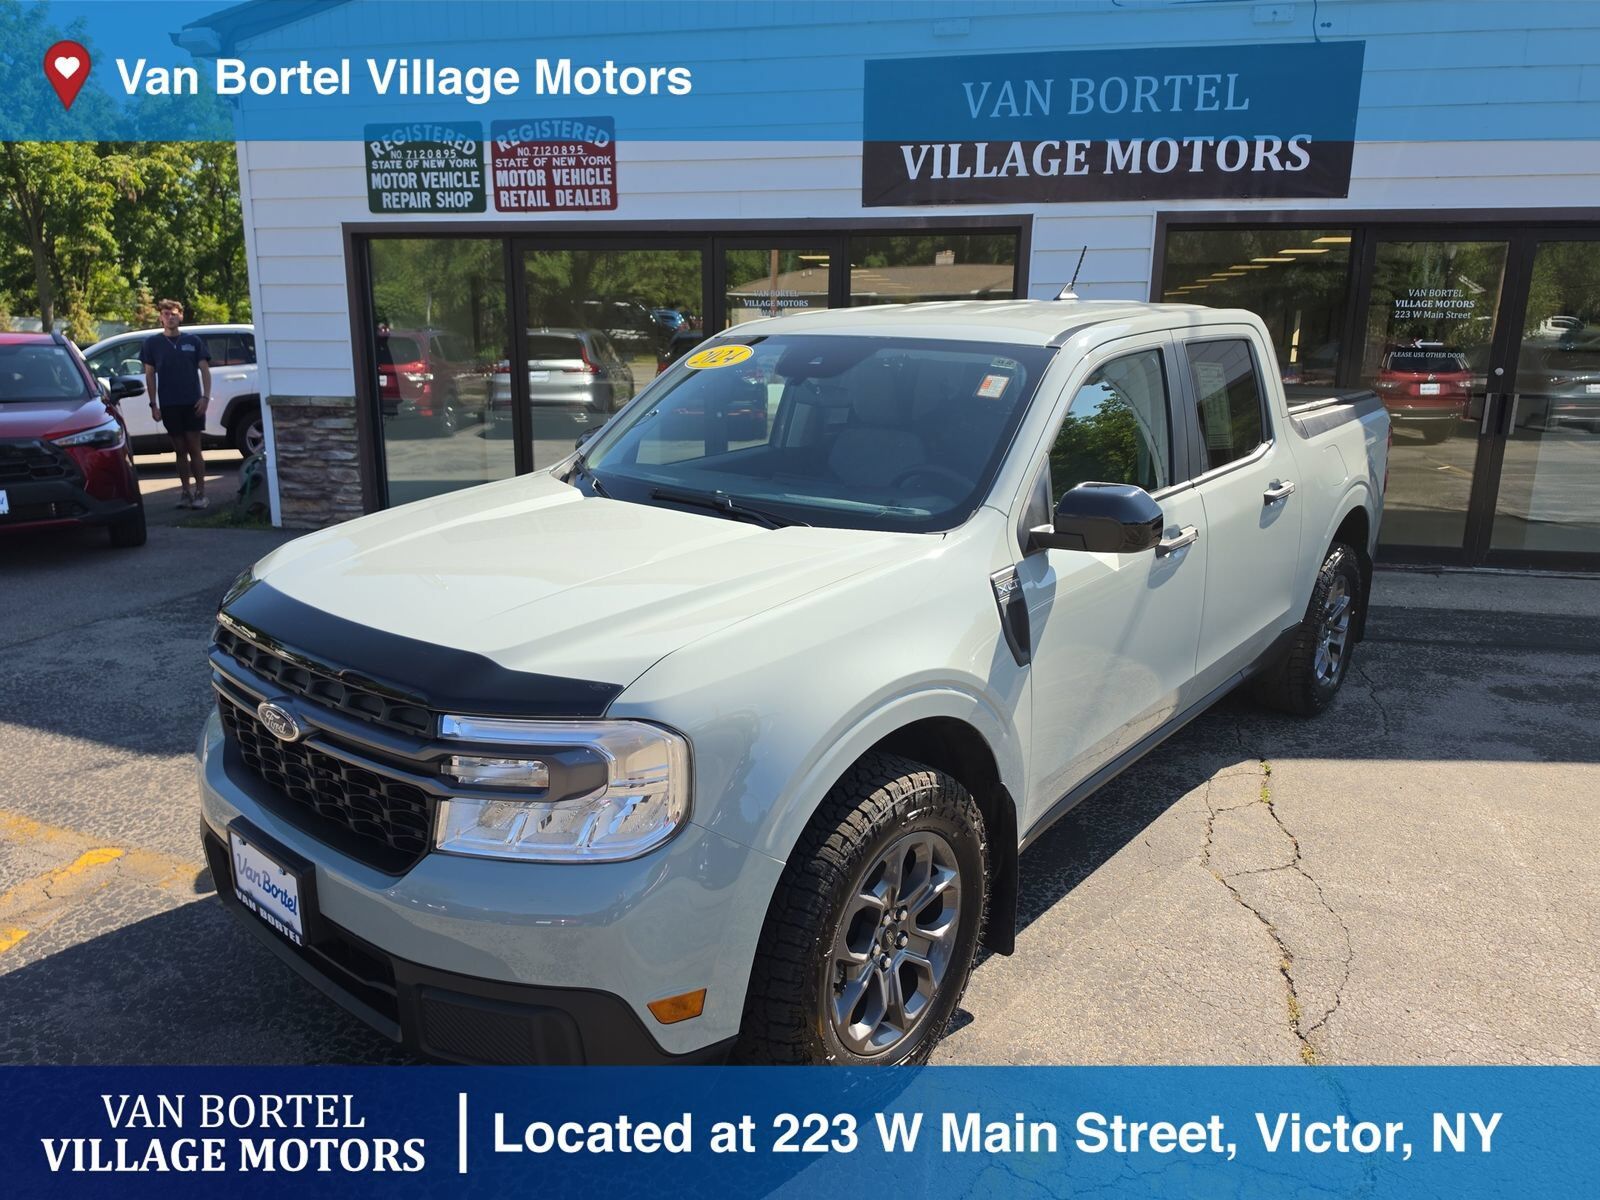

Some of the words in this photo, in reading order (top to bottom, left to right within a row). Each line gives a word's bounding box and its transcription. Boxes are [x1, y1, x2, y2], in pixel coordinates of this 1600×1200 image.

[962, 79, 1054, 118] VAN
[1067, 73, 1250, 115] BORTEL
[370, 124, 476, 158] REGISTERED
[495, 120, 610, 152] REGISTERED
[391, 150, 403, 159] NO.
[406, 149, 457, 159] 7120895
[517, 147, 531, 156] NO.
[533, 145, 584, 155] 7120895
[900, 139, 1091, 181] VILLAGE
[1103, 134, 1312, 175] MOTORS
[371, 160, 402, 169] STATE
[405, 160, 420, 169] OF
[422, 159, 445, 168] NEW
[449, 159, 478, 168] YORK
[495, 158, 529, 168] STATE
[533, 157, 548, 167] OF
[552, 157, 576, 166] NEW
[580, 156, 612, 165] YORK
[371, 172, 418, 189] MOTOR
[420, 171, 480, 188] VEHICLE
[496, 169, 546, 187] MOTOR
[552, 168, 612, 186] VEHICLE
[382, 192, 431, 208] REPAIR
[436, 191, 474, 207] SHOP
[499, 190, 550, 207] RETAIL
[555, 189, 611, 206] DEALER
[1408, 289, 1427, 297] VAN
[1429, 289, 1464, 297] BORTEL
[743, 299, 775, 307] VILLAGE
[777, 299, 808, 307] MOTORS
[1395, 300, 1433, 308] VILLAGE
[1435, 300, 1475, 308] MOTORS
[1424, 311, 1444, 319] Main
[1446, 311, 1471, 319] Street
[690, 350, 746, 365] 2024
[265, 710, 286, 735] Ford
[237, 853, 261, 888] Van
[262, 870, 297, 916] Bortel
[235, 888, 257, 912] VAN
[259, 907, 303, 947] BORTEL
